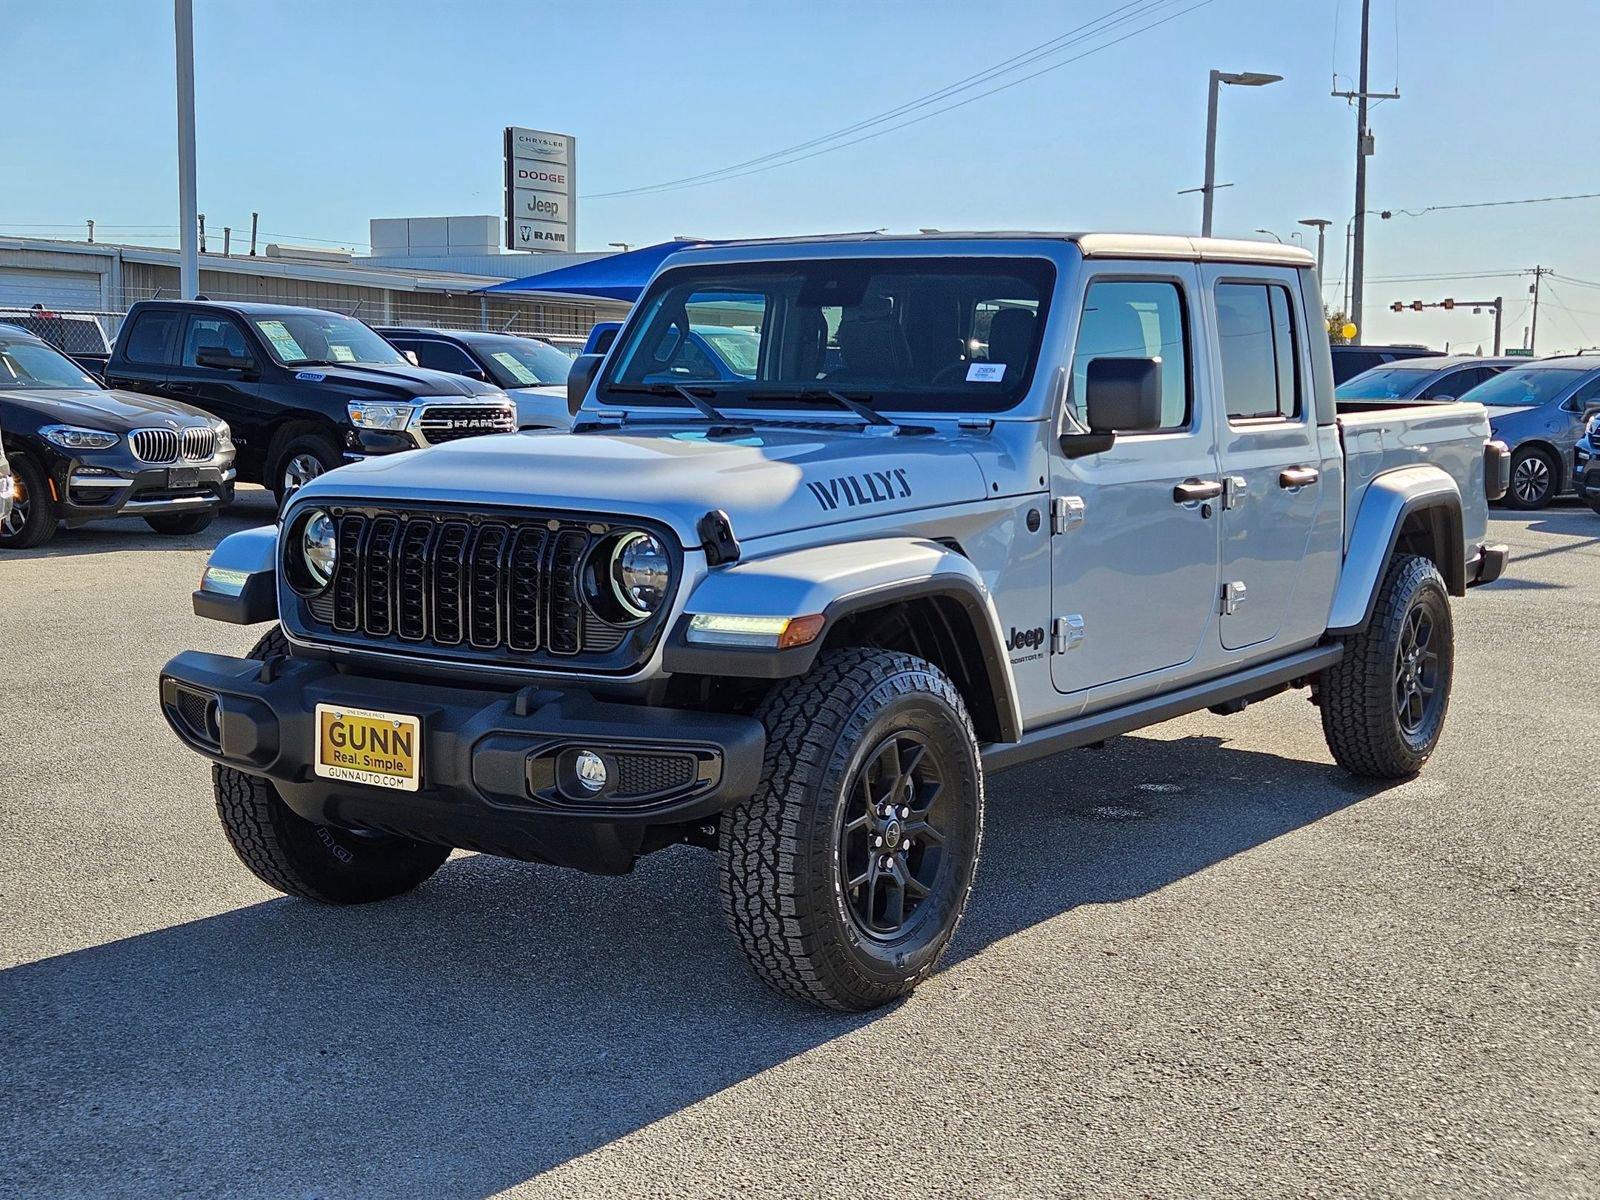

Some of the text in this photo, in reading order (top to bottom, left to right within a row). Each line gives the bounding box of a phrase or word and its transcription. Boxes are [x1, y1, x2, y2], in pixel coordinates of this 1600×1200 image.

[518, 136, 563, 148] CHRYSLER
[518, 169, 565, 184] DODGE
[527, 195, 559, 217] Jeep
[534, 230, 565, 242] RAM
[454, 419, 494, 428] RAM
[806, 468, 912, 511] WILLYS
[1006, 627, 1045, 651] Jeep
[329, 721, 412, 757] GUNN
[333, 750, 360, 765] Real.
[328, 767, 404, 789] GUNNAUTO.COM
